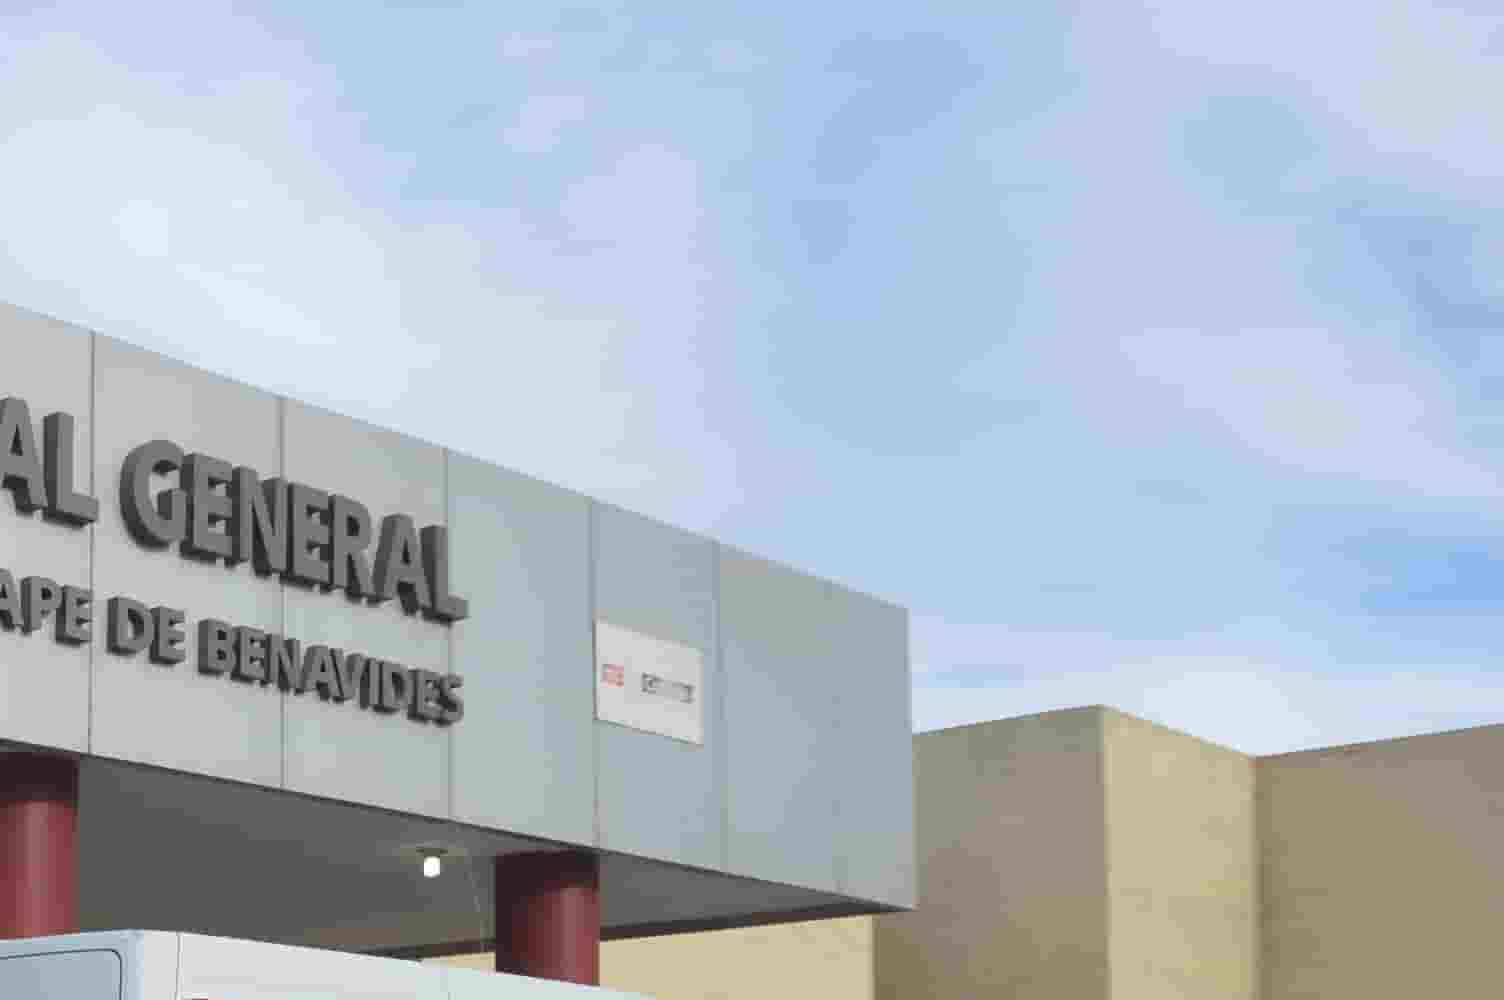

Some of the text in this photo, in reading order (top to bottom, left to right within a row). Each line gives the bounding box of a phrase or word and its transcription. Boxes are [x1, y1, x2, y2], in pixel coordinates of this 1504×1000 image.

[120, 440, 468, 623] GENERAL
[108, 596, 186, 664] DE
[198, 618, 465, 726] BENAVIDES
